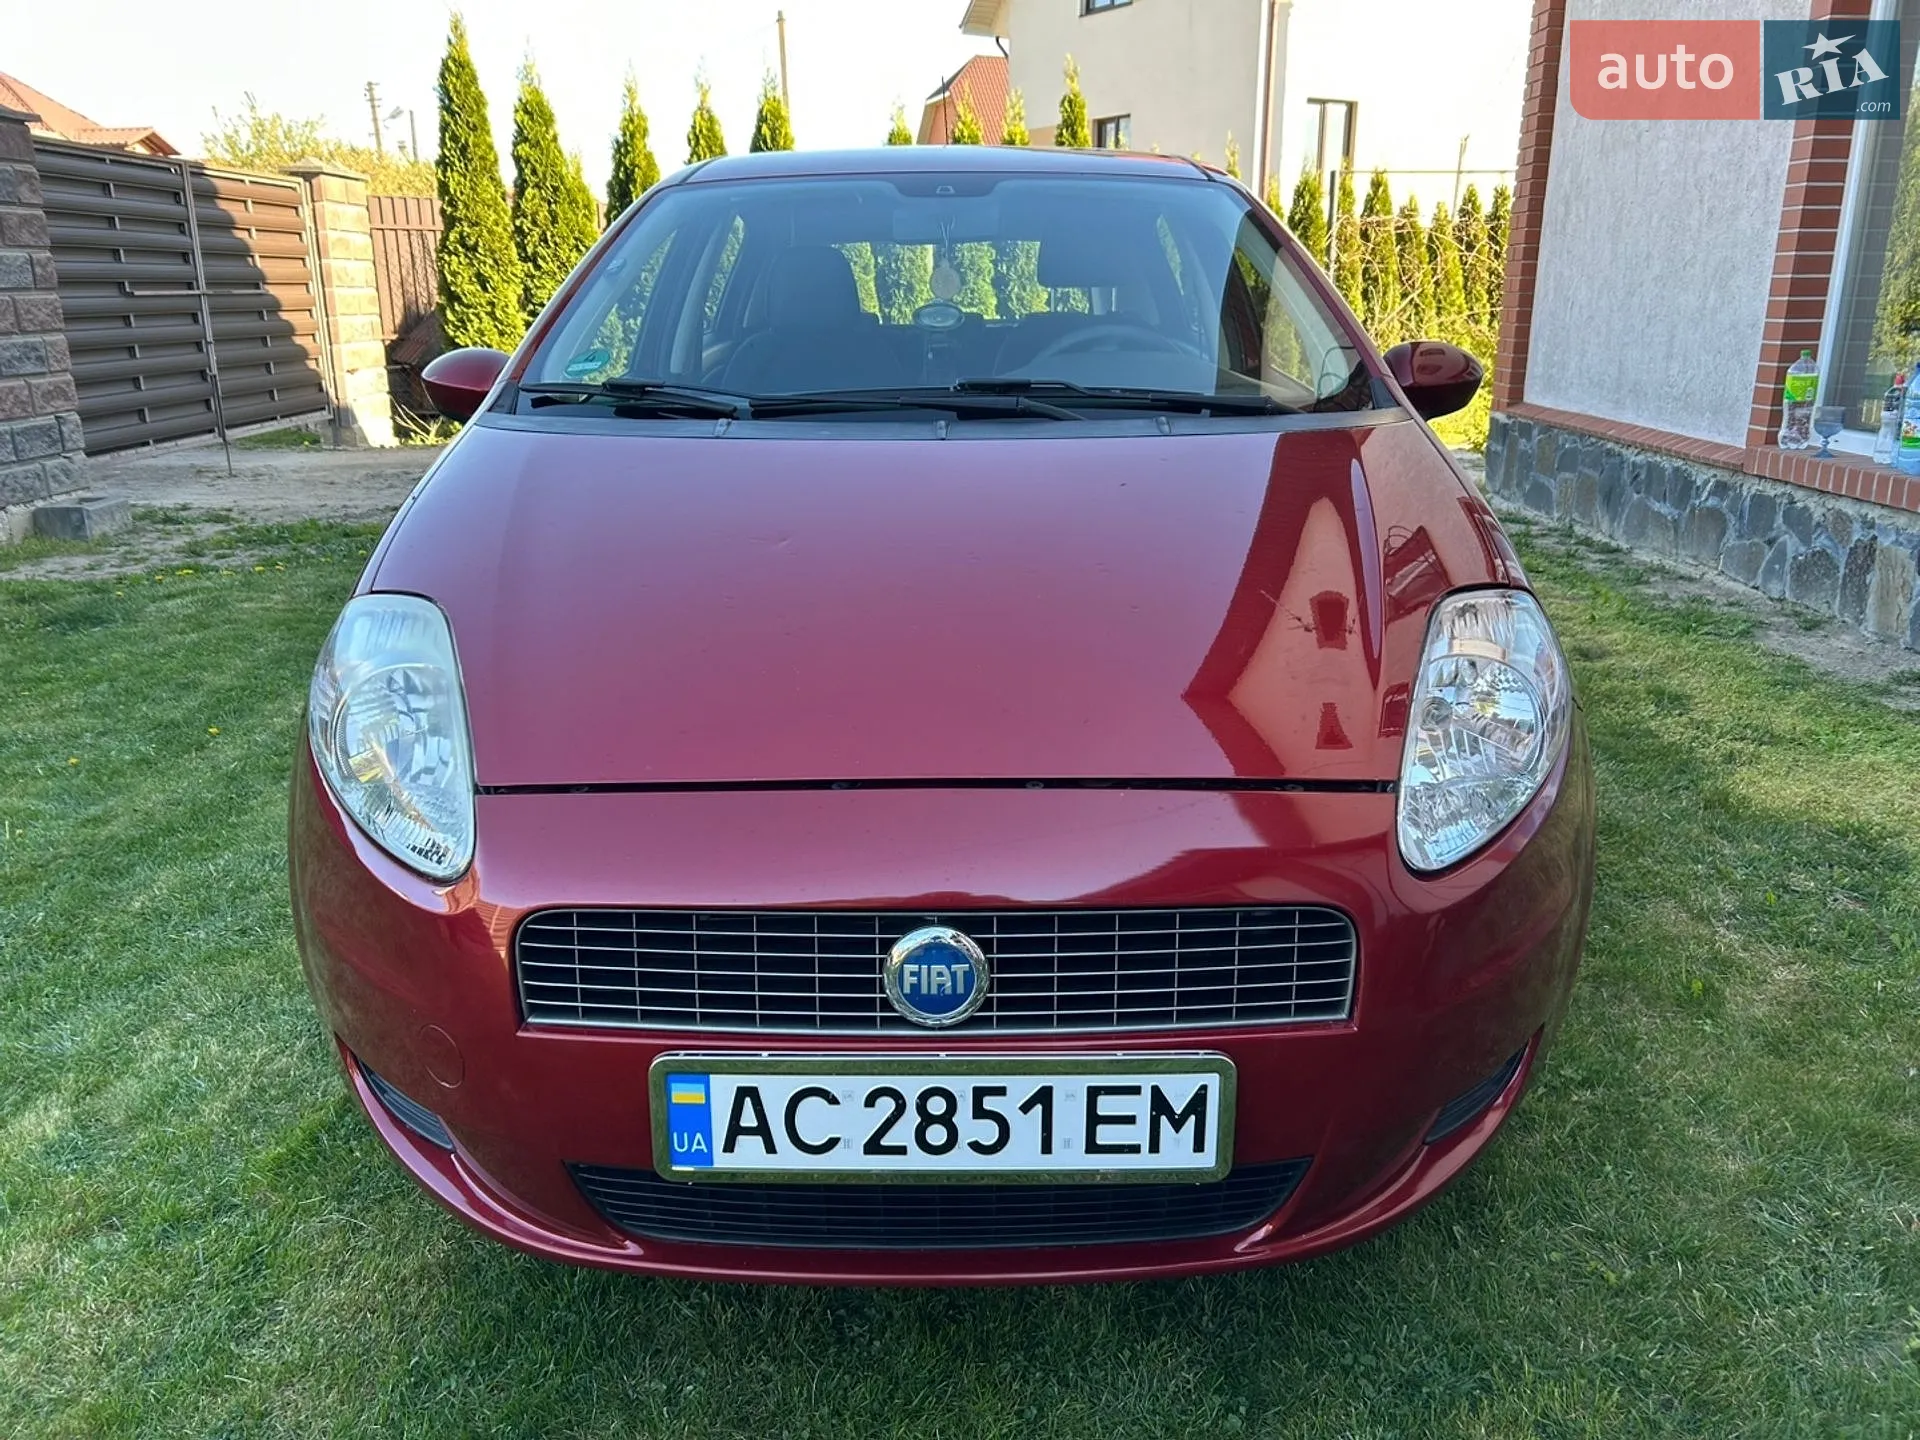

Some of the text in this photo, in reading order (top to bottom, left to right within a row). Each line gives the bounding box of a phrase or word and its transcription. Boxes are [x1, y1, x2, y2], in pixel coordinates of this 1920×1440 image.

[903, 964, 970, 994] FIAT
[722, 1084, 1208, 1155] AC 2851 EM
[673, 1132, 708, 1153] UA
